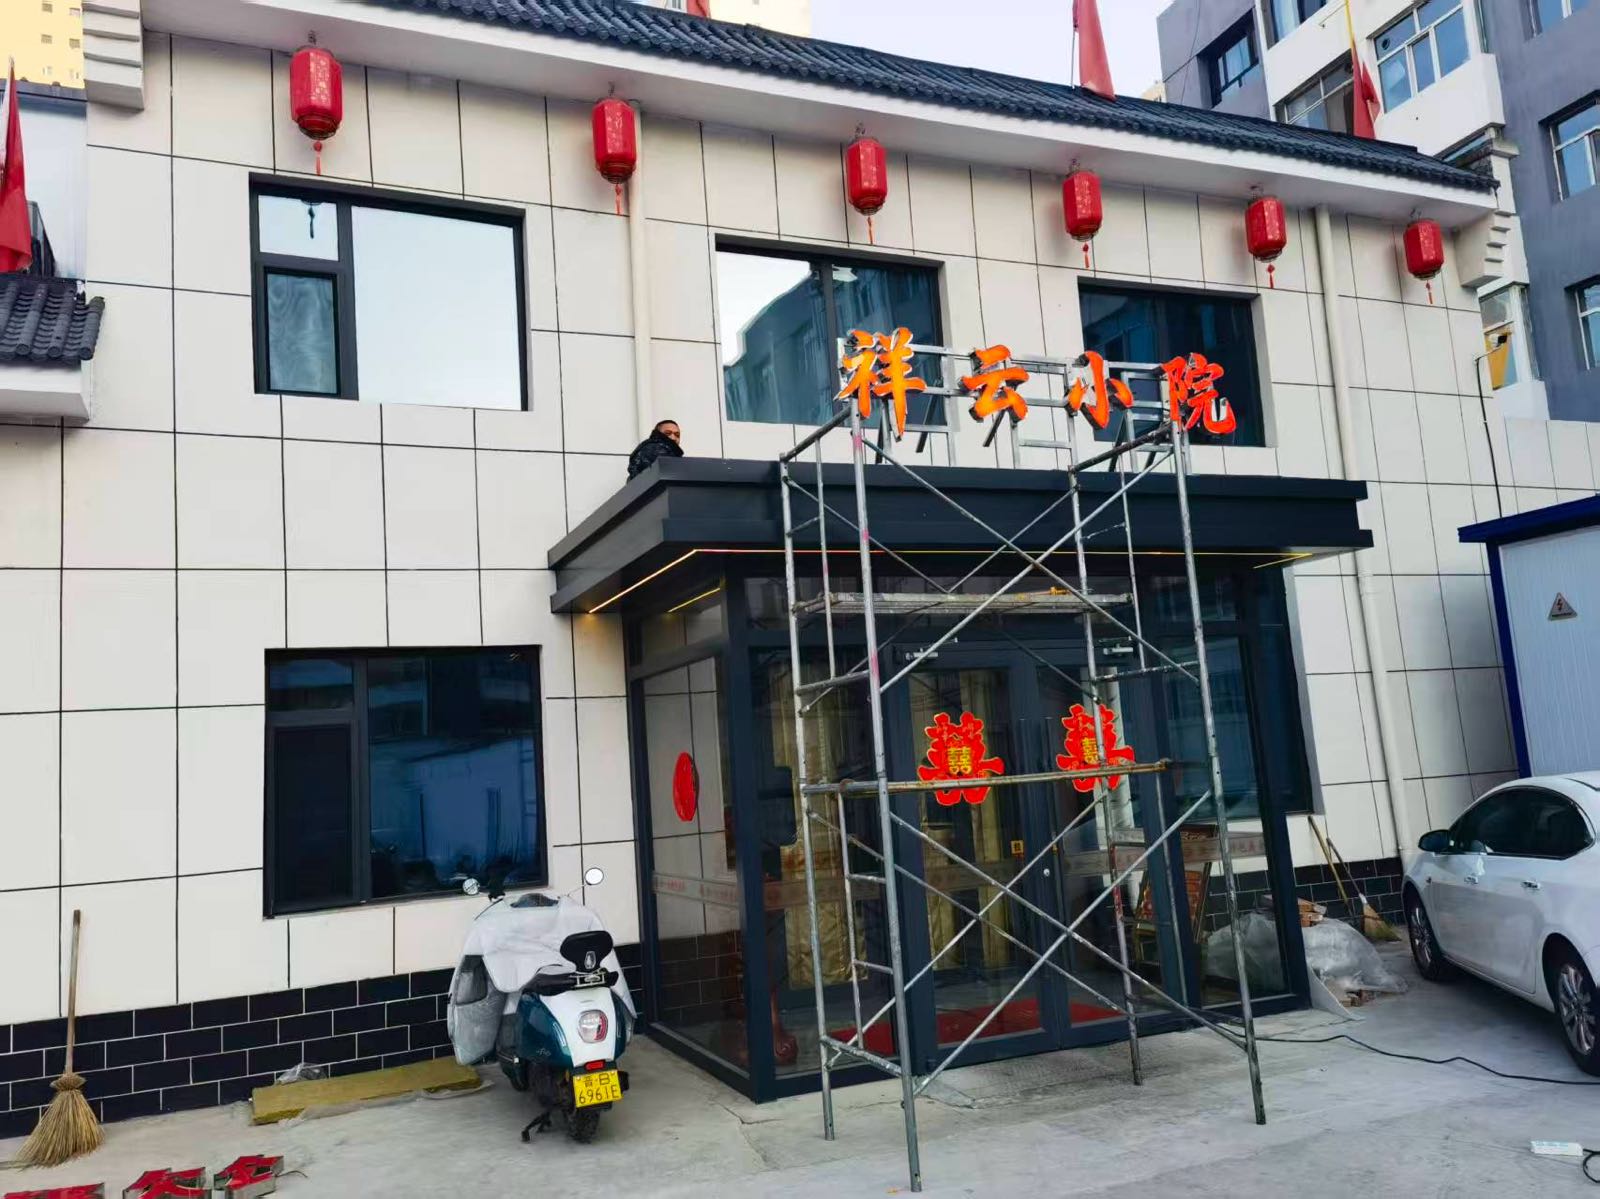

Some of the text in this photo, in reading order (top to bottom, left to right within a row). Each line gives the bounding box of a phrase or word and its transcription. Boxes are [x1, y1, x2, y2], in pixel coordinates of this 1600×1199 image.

[835, 327, 1236, 441] 祥云小院
[579, 1085, 619, 1104] 6961E
